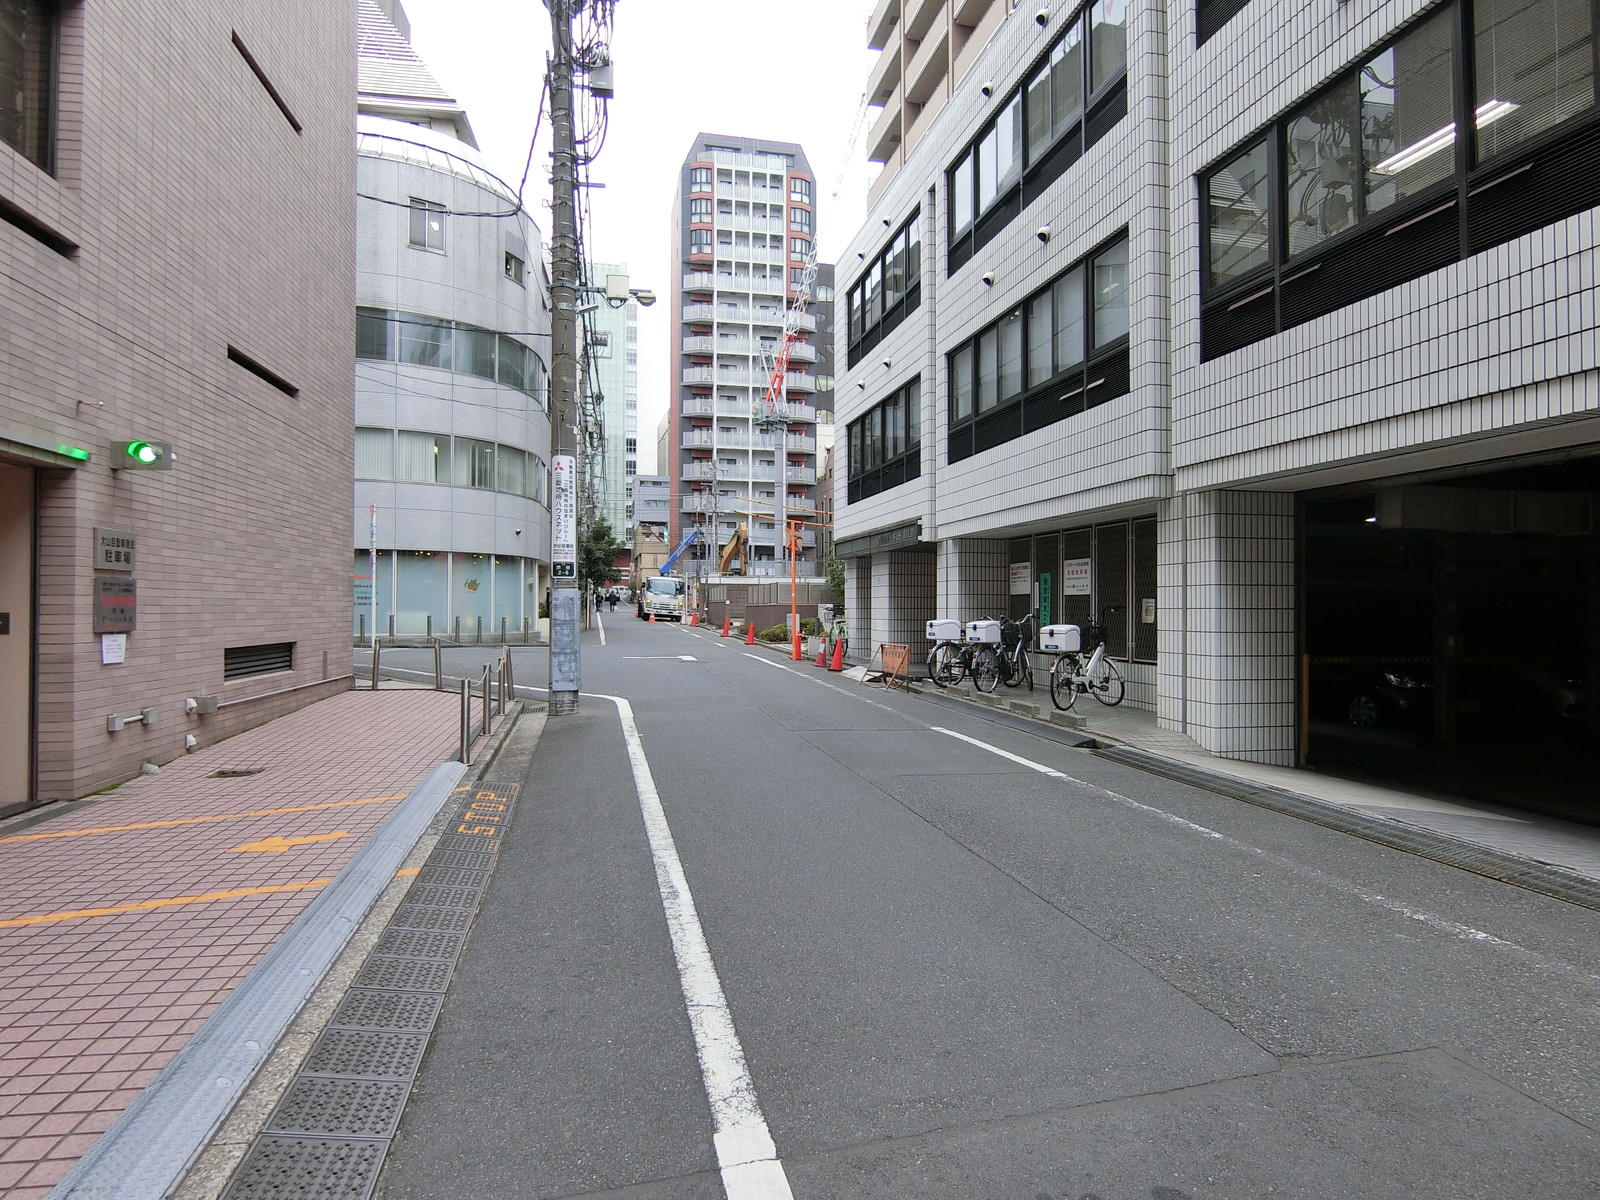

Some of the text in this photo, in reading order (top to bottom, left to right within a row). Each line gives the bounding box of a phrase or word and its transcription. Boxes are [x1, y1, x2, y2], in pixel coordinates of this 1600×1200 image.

[104, 549, 131, 564] 駐車場
[458, 792, 507, 836] STOP
